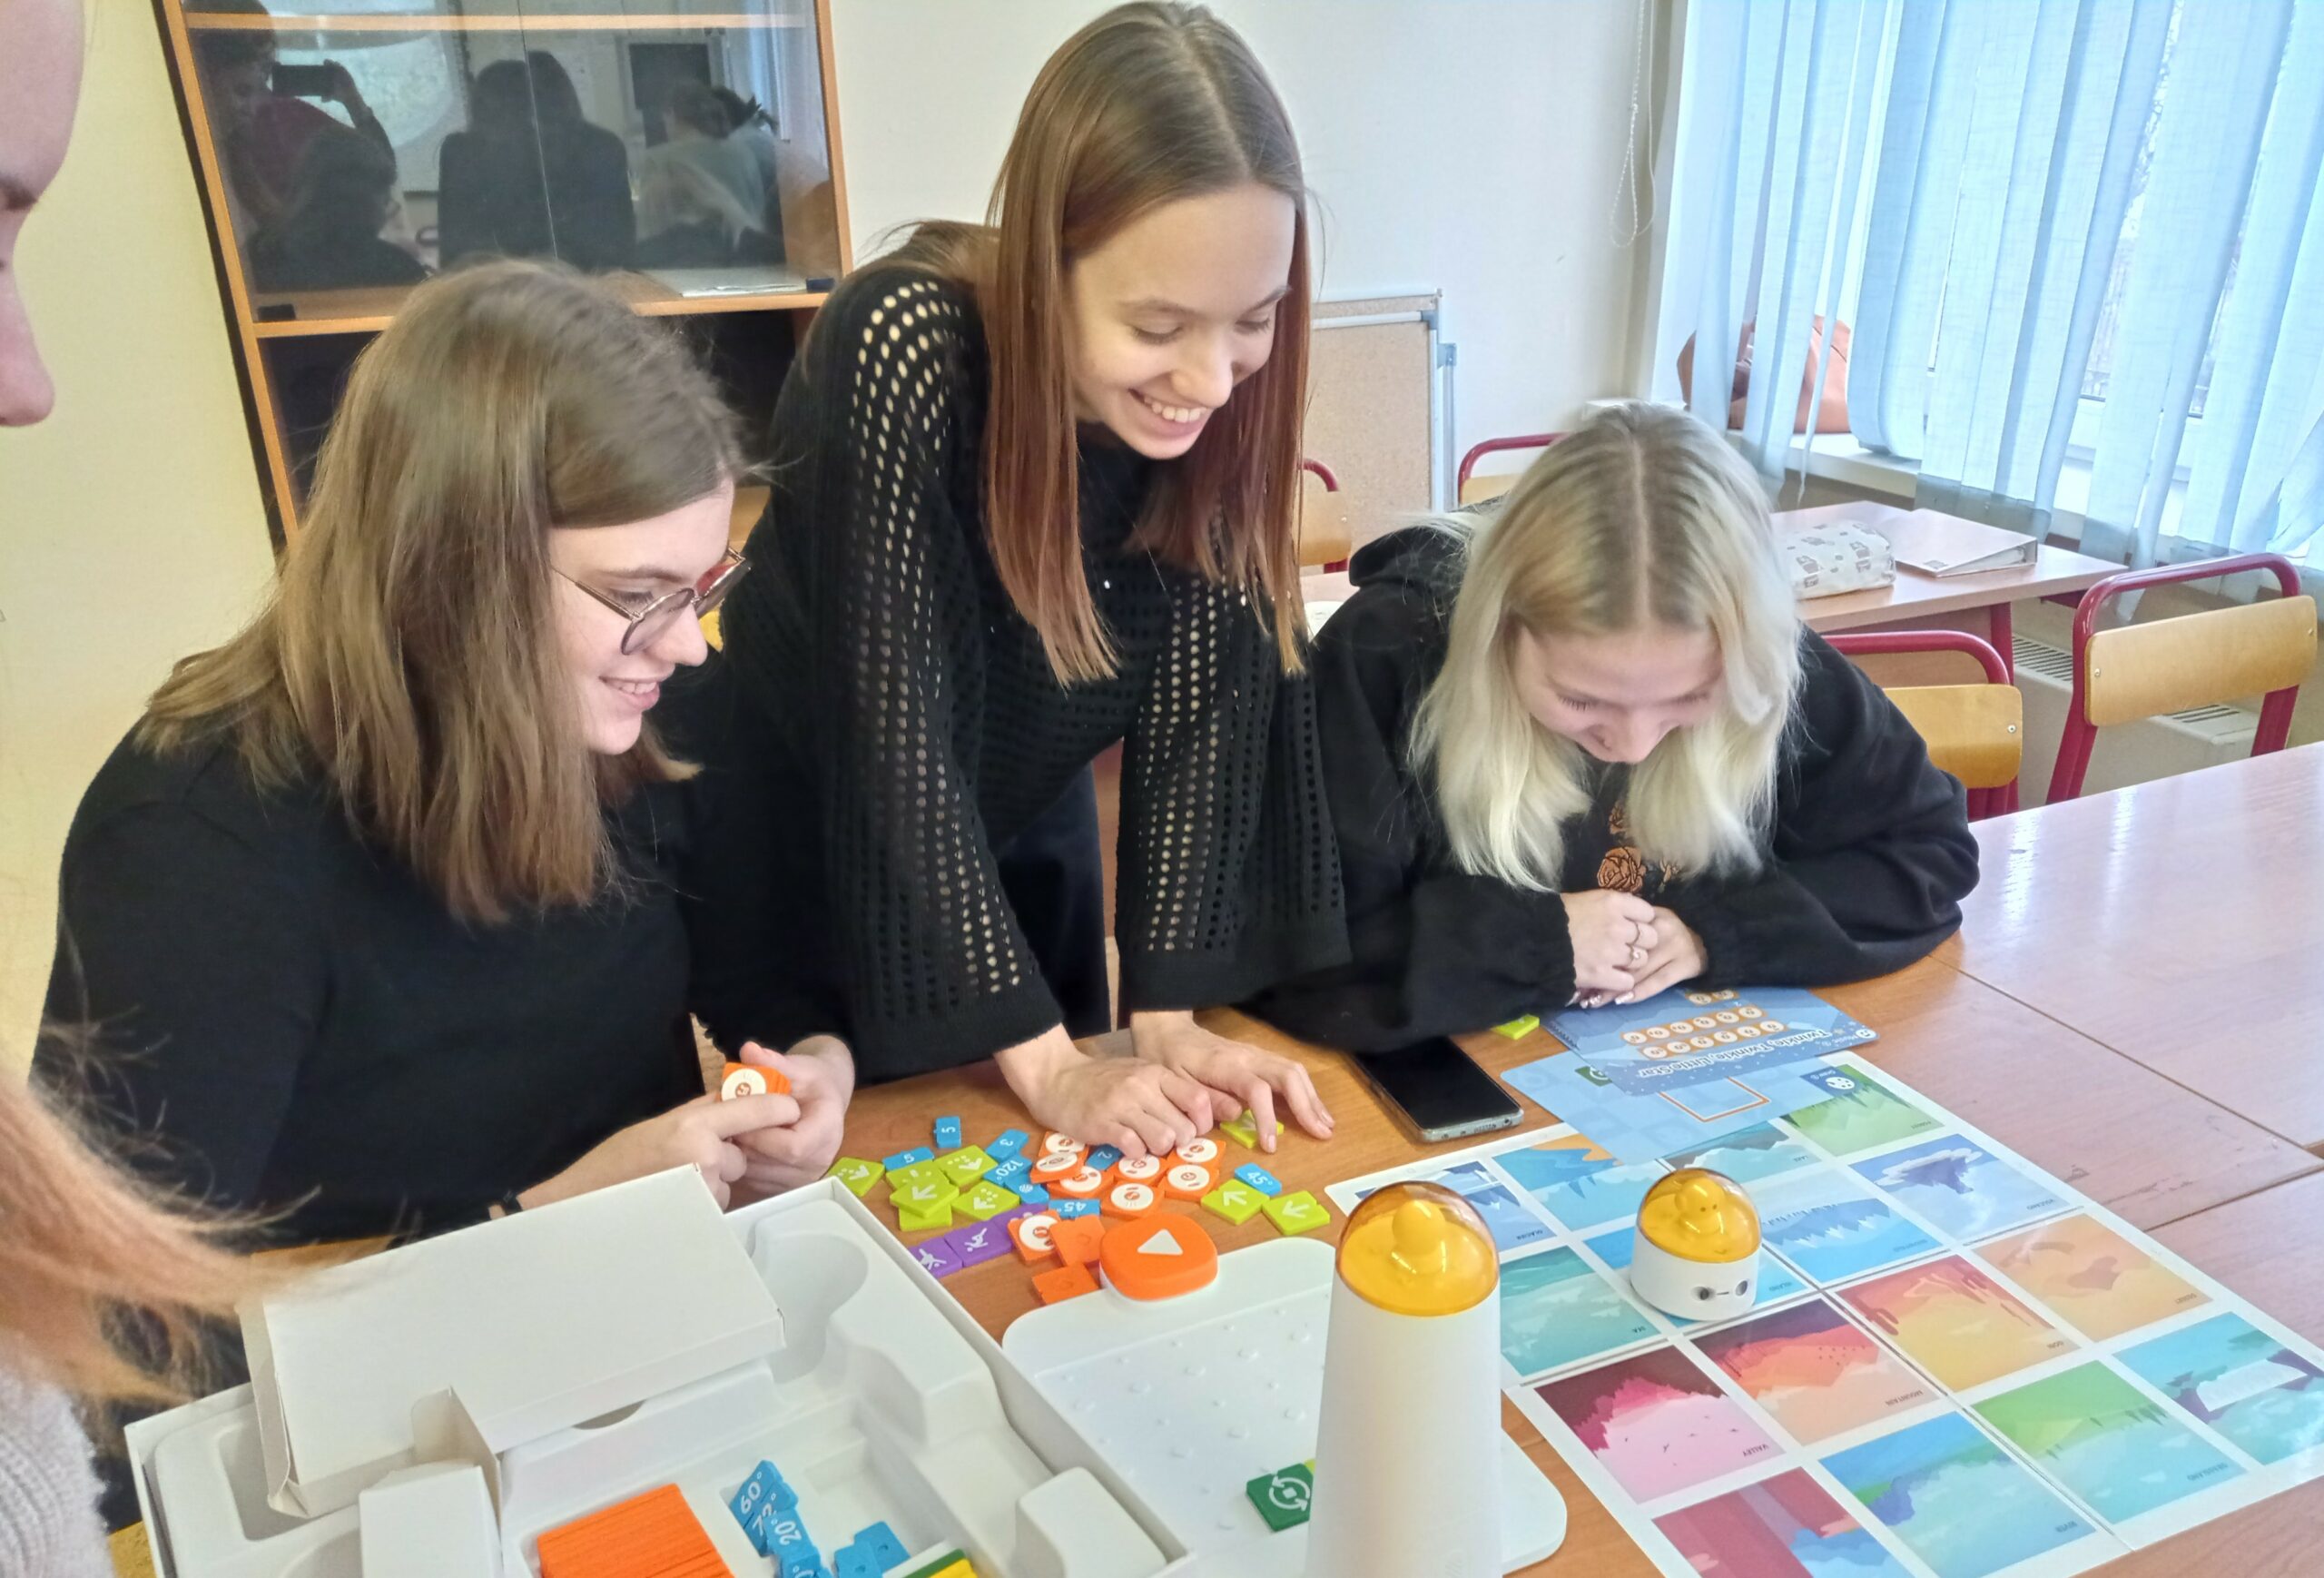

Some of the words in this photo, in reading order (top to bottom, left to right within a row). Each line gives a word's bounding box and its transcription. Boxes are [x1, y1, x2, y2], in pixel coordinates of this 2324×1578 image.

[1676, 1056, 1712, 1071] Little
[1638, 1063, 1675, 1079] Star
[941, 1126, 956, 1134] 5
[1000, 1139, 1014, 1147] 3
[1097, 1150, 1113, 1159] 2
[1246, 1170, 1274, 1186] 45°
[1742, 1444, 1769, 1456] VALLEY
[740, 1471, 763, 1514] 60°
